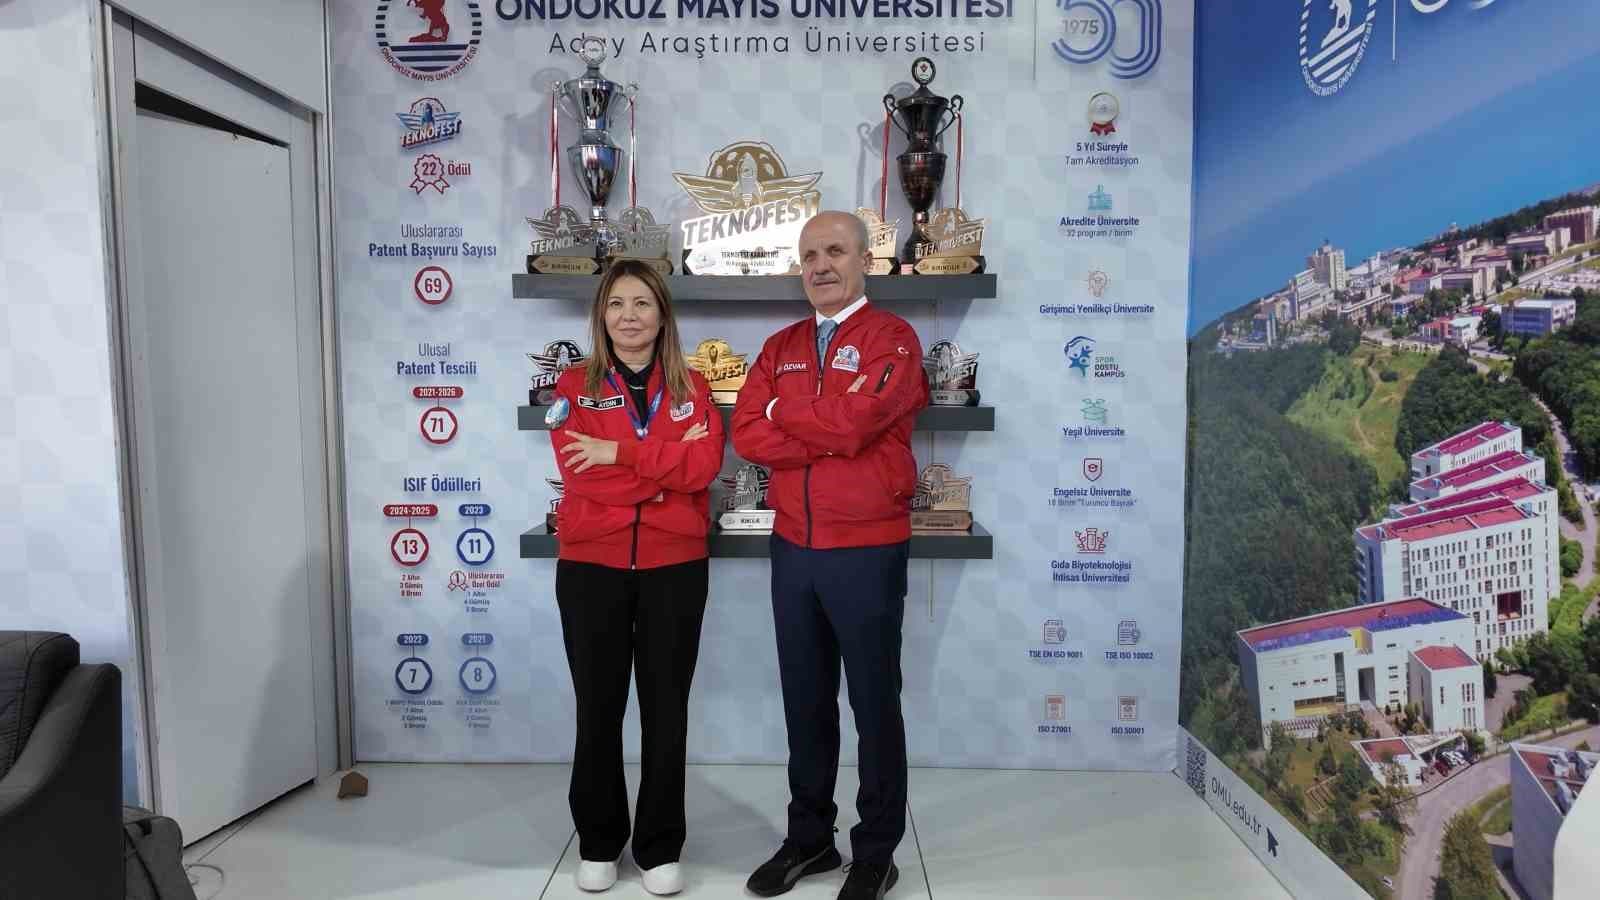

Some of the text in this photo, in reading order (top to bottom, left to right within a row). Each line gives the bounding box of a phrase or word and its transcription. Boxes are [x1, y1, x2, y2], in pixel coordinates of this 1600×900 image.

[496, 0, 666, 20] ONDOKUZ
[677, 0, 781, 19] MAYIS
[1061, 19, 1099, 35] 1975
[640, 31, 789, 59] Araştırma
[806, 27, 985, 54] Üniversitesi
[400, 119, 462, 147] TEKNOFEST
[1076, 141, 1128, 153] 5 Yıl Süreyle
[422, 160, 471, 176] 22 Ödül
[1065, 155, 1139, 168] Tam Akreditasyon
[684, 191, 820, 246] TEKNOFEST
[1060, 214, 1140, 226] Akredite Üniversite
[401, 223, 463, 238] Uluslararası
[1067, 229, 1075, 237] 32
[1077, 230, 1107, 240] program
[1114, 229, 1133, 237] birim
[368, 242, 497, 259] Patent Başvuru Sayısı
[424, 278, 442, 293] 69
[1040, 301, 1155, 315] Girişimci Yenilikçi Üniversite
[418, 343, 450, 357] Ulusal
[397, 361, 477, 375] Patent Tescili
[430, 418, 443, 433] 71
[1063, 425, 1125, 438] Yeşil Üniversite
[404, 473, 481, 492] ISIF Ödülleri
[1053, 485, 1132, 498] Engelsiz Üniversite
[390, 506, 430, 515] 2024-2025
[402, 539, 418, 555] 13
[468, 538, 481, 554] 11
[1051, 560, 1132, 572] Gıda Biyoteknolojisi
[456, 573, 460, 583] 1
[1053, 570, 1130, 582] İhtisas Üniversitesi
[1029, 650, 1042, 658] TSE
[1105, 651, 1118, 660] TSE
[1119, 652, 1131, 660] ISO
[409, 668, 417, 684] 7
[474, 666, 482, 682] 8
[1038, 725, 1071, 733] ISO 27001
[1111, 726, 1123, 734] ISO
